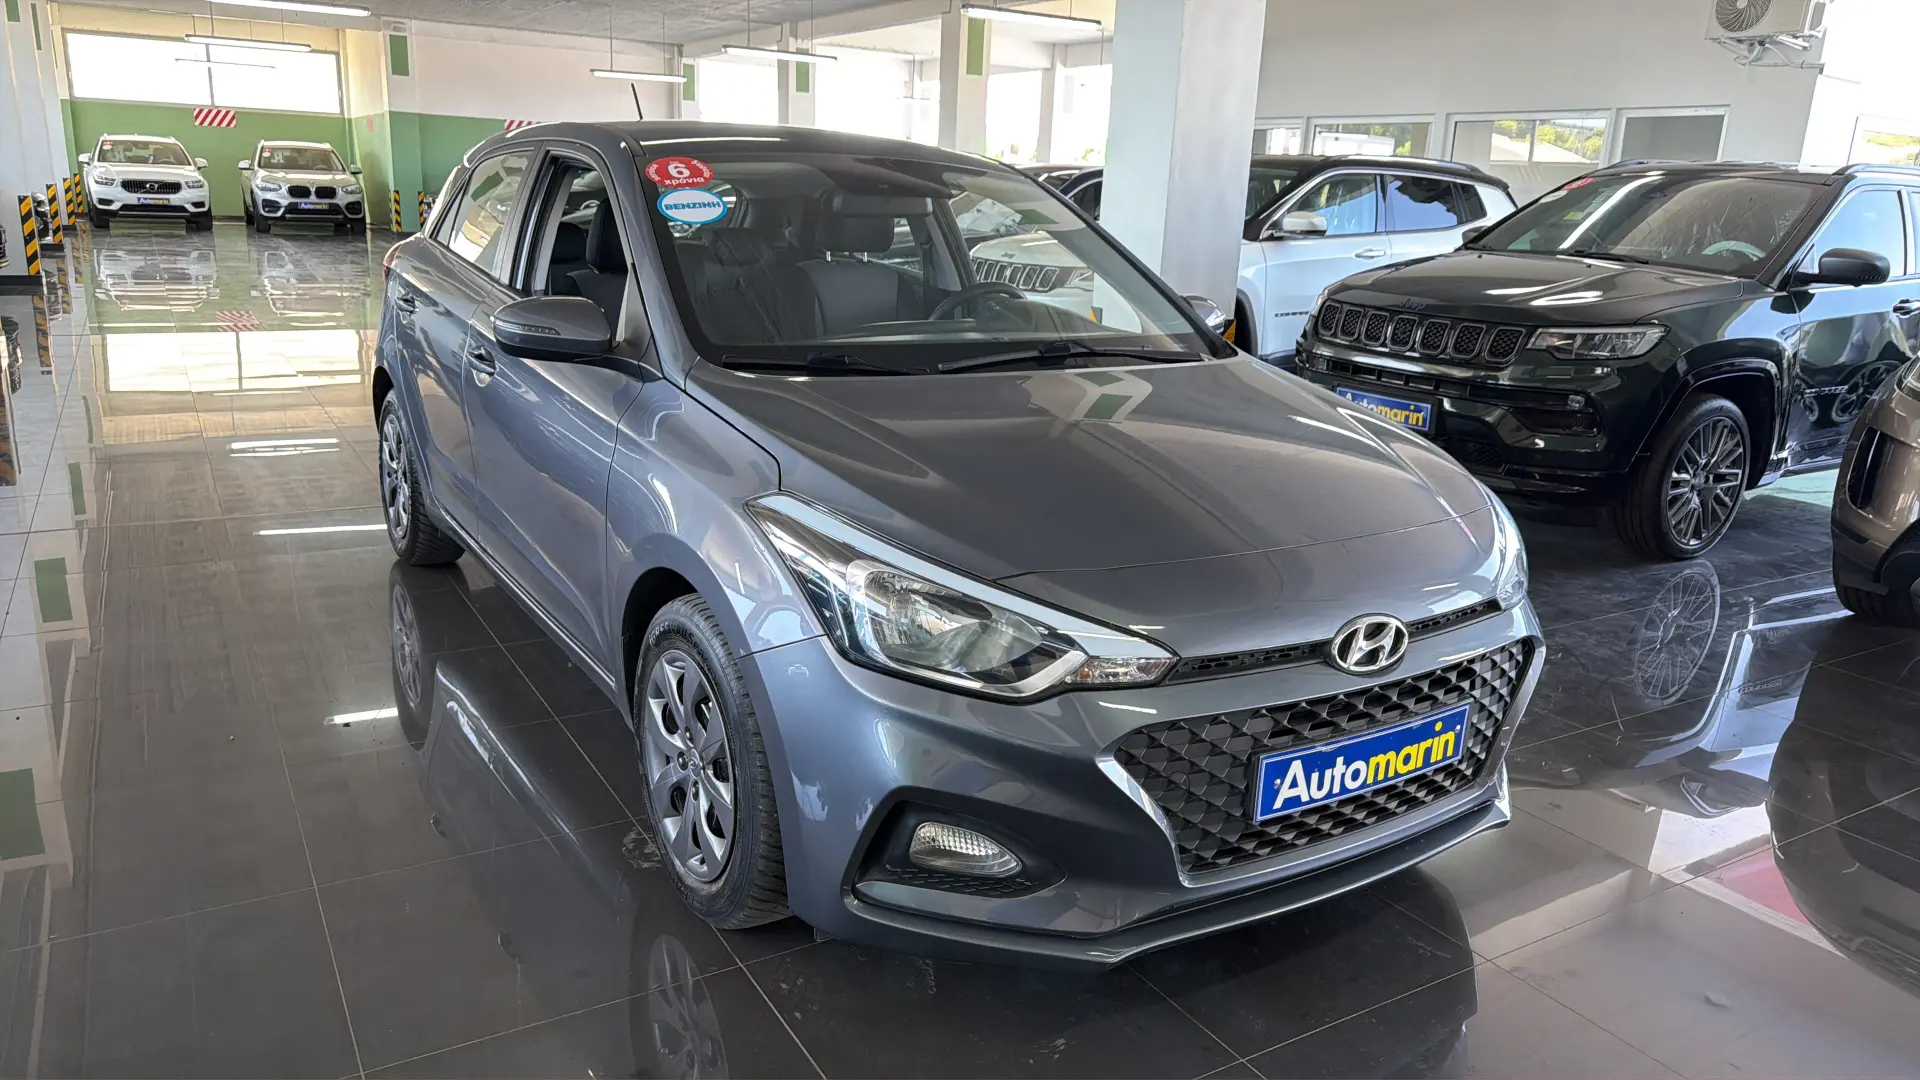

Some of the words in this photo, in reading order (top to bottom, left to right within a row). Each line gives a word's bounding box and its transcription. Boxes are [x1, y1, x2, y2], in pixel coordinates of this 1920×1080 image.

[667, 163, 691, 178] 6
[664, 177, 705, 185] χρόνια
[1272, 720, 1457, 809] Automarin
